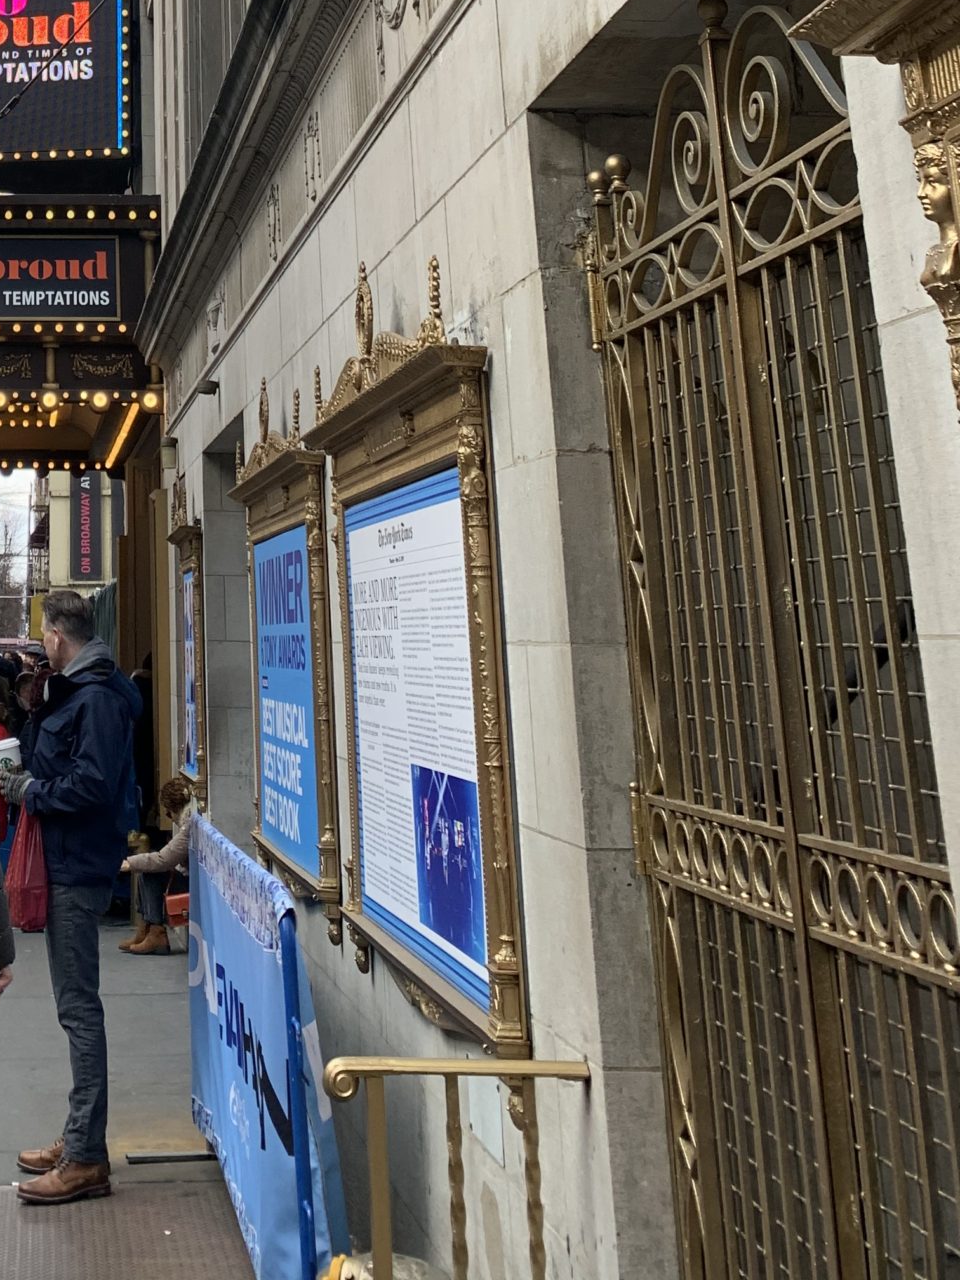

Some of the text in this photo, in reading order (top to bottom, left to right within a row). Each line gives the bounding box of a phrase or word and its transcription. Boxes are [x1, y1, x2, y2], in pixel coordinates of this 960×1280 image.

[76, 47, 93, 57] OF
[3, 290, 110, 306] TEMPTATIONS
[81, 492, 91, 554] BROADWAY
[81, 558, 91, 573] ON
[258, 550, 304, 626] WINNER
[368, 579, 380, 603] AND
[380, 576, 398, 602] MORE
[381, 605, 399, 630] WITH
[263, 635, 277, 669] TONY
[278, 634, 306, 671] AWARDS
[262, 697, 309, 749] BEST MUSICAL
[263, 740, 303, 797] BEST SCORE
[264, 784, 301, 845] BEST BOOK
